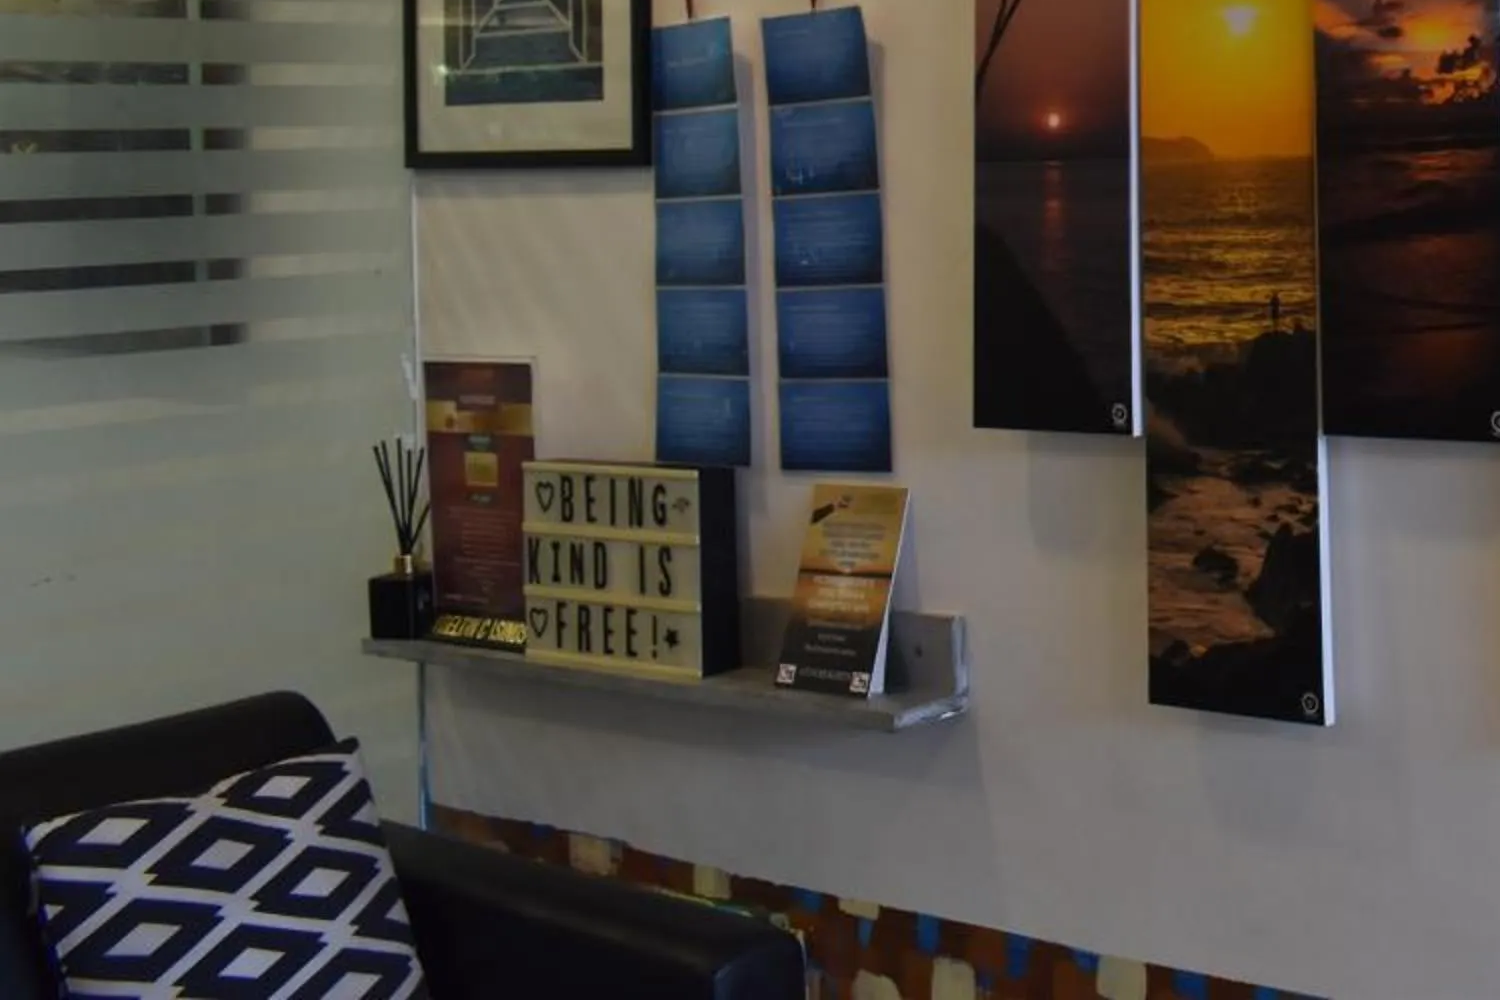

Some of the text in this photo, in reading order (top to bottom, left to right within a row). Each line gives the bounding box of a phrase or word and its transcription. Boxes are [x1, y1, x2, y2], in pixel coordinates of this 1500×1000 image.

[559, 474, 667, 528] BEING
[527, 536, 608, 590] KIND
[639, 545, 673, 597] IS
[556, 601, 658, 660] FREE!
